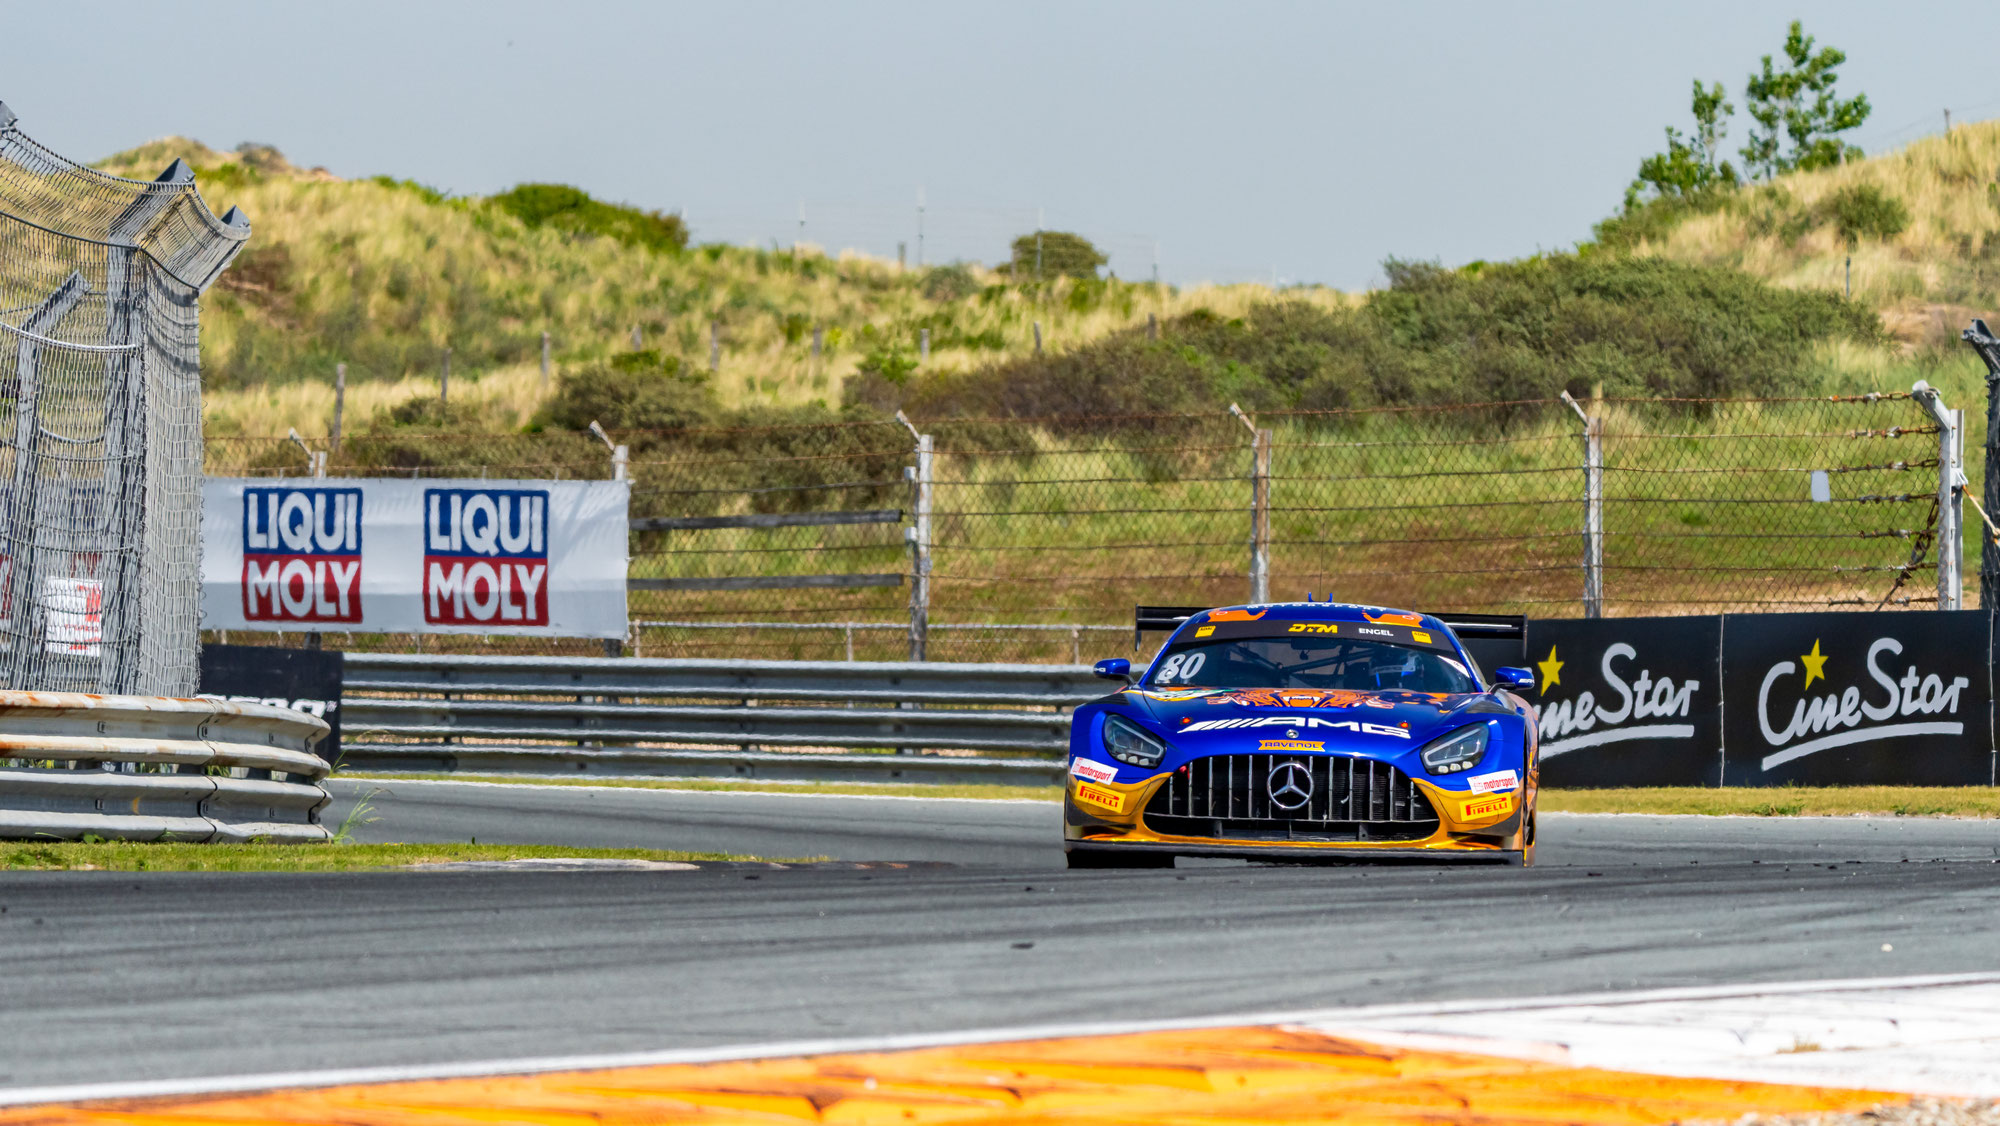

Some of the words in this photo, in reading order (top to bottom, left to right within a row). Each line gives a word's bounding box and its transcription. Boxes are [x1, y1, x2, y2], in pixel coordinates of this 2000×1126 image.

[247, 492, 359, 554] LIQUI
[429, 493, 544, 557] LIQUI
[247, 558, 361, 618] MOLY
[429, 561, 546, 621] MOLY
[1288, 623, 1338, 634] DTM
[1358, 627, 1394, 637] ENGEL
[1156, 652, 1206, 681] 80
[1532, 642, 1700, 742] ineStar
[1757, 637, 1970, 746] CineStar
[1250, 716, 1411, 739] AMG
[1265, 741, 1320, 749] RAVENOL
[1079, 765, 1112, 781] motorsport
[1483, 776, 1516, 790] motorsport
[1079, 785, 1120, 808] PIRELLI
[1465, 797, 1508, 816] PIRELLI
